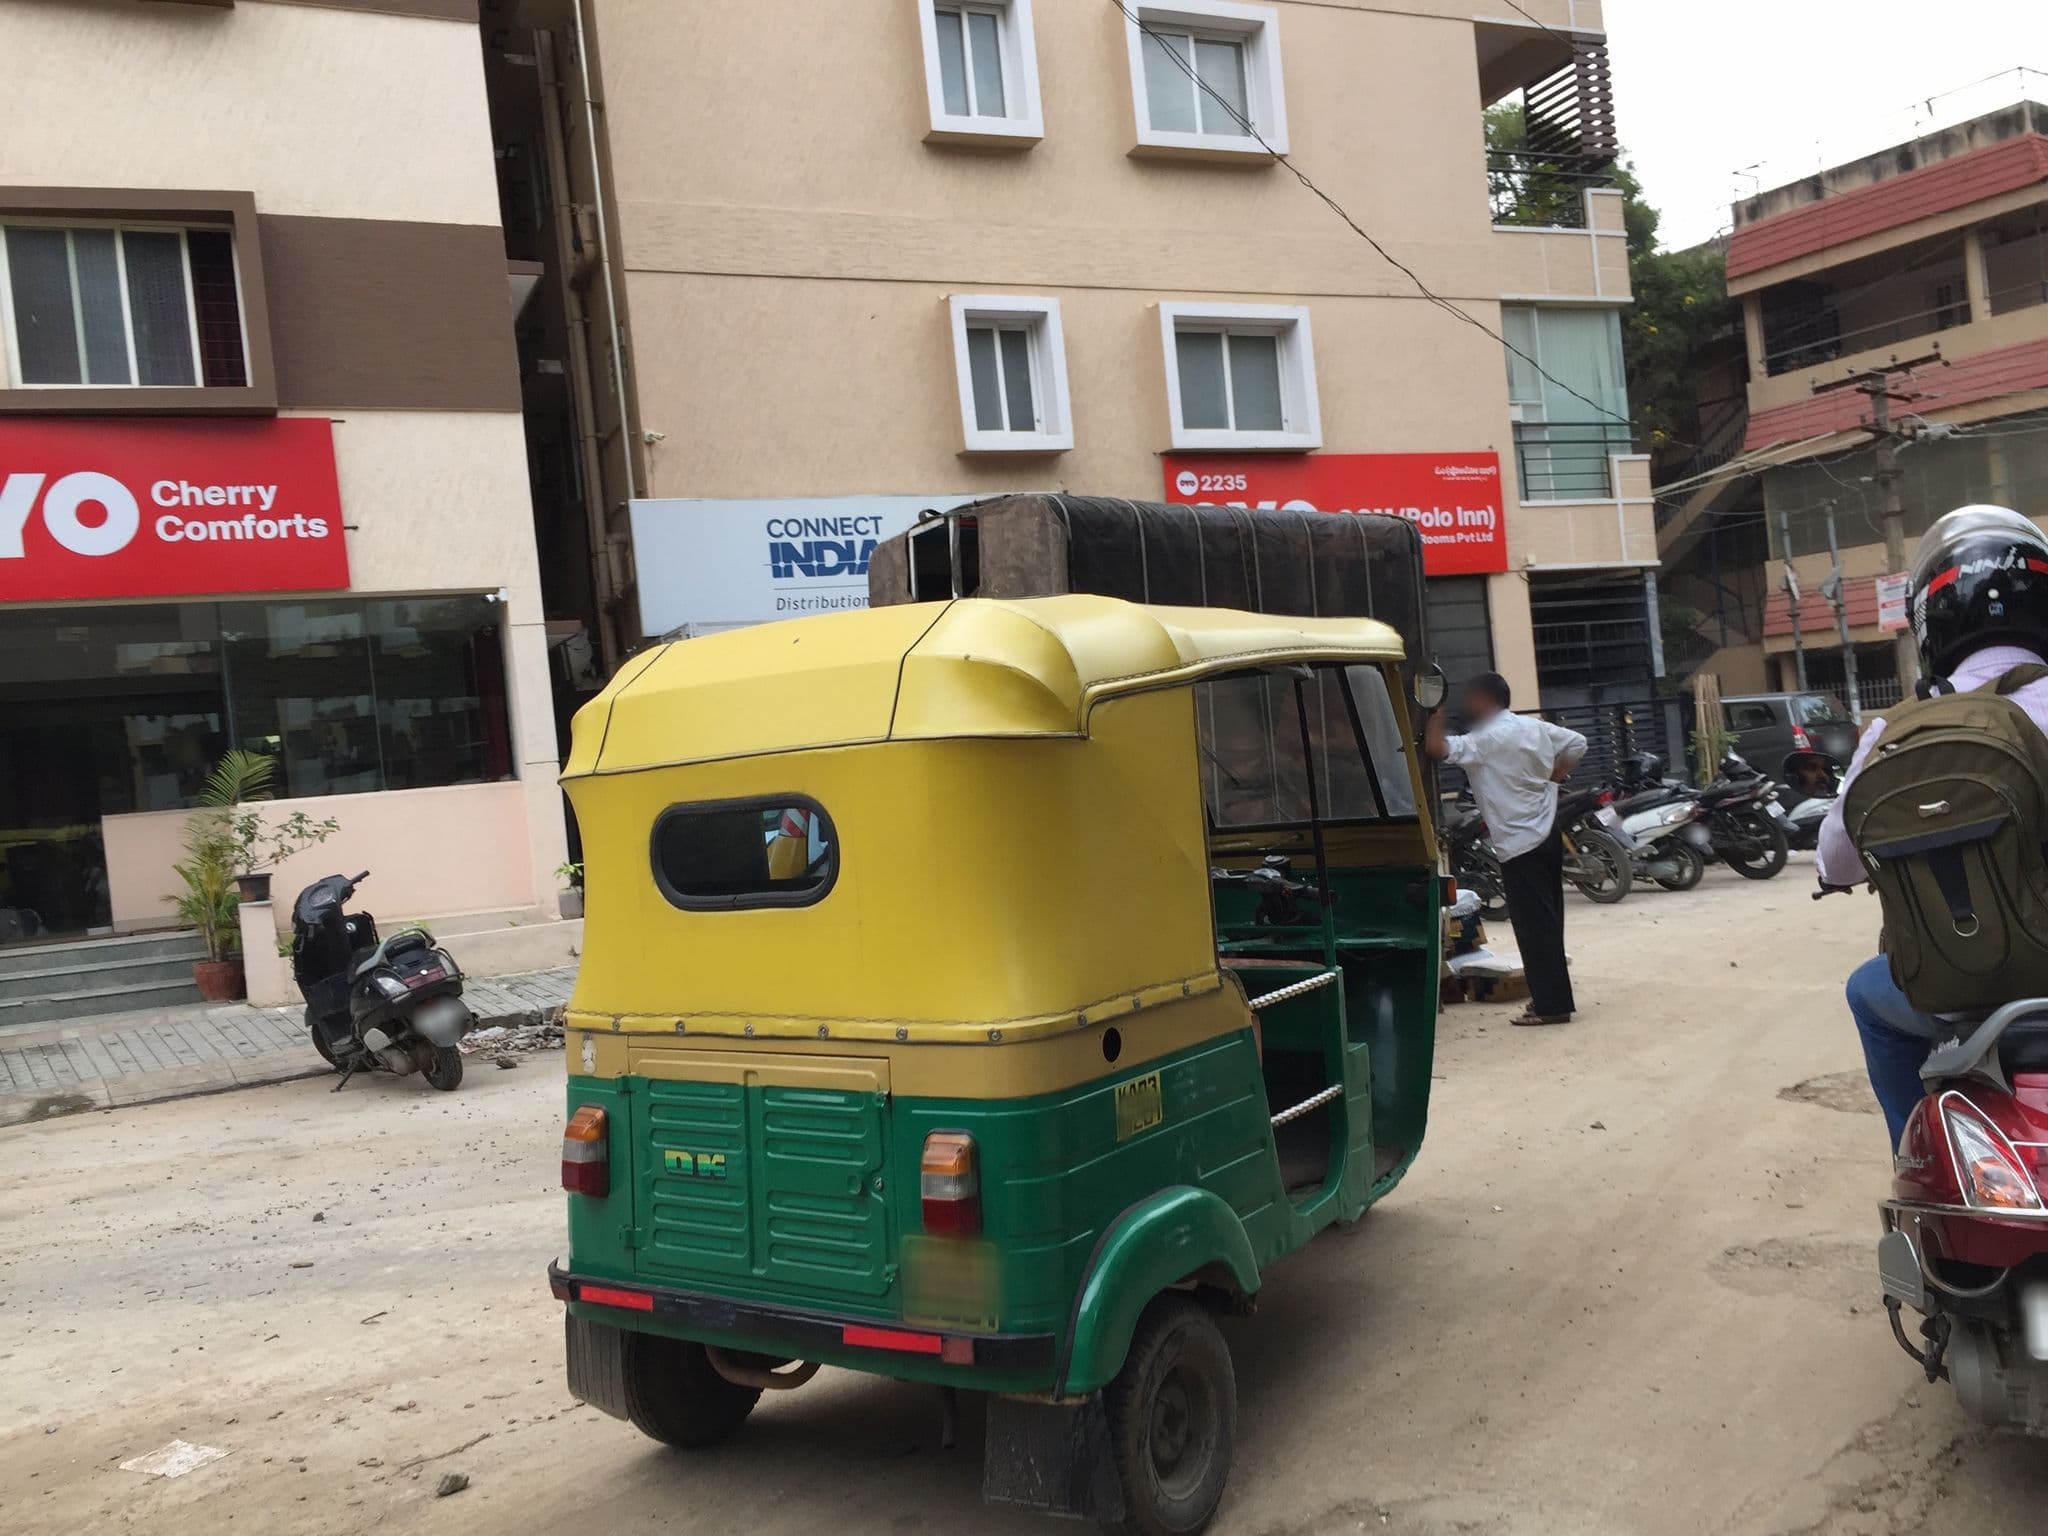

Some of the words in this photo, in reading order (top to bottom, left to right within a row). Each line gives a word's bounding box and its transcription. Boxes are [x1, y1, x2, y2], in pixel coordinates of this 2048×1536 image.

[1201, 474, 1248, 491] 2235
[151, 480, 277, 510] Cherry
[155, 513, 329, 542] Comforts
[766, 516, 883, 538] CONNECT
[1456, 505, 1496, 530] Inn)
[1456, 532, 1476, 543] Pvt
[1475, 532, 1494, 542] Ltd
